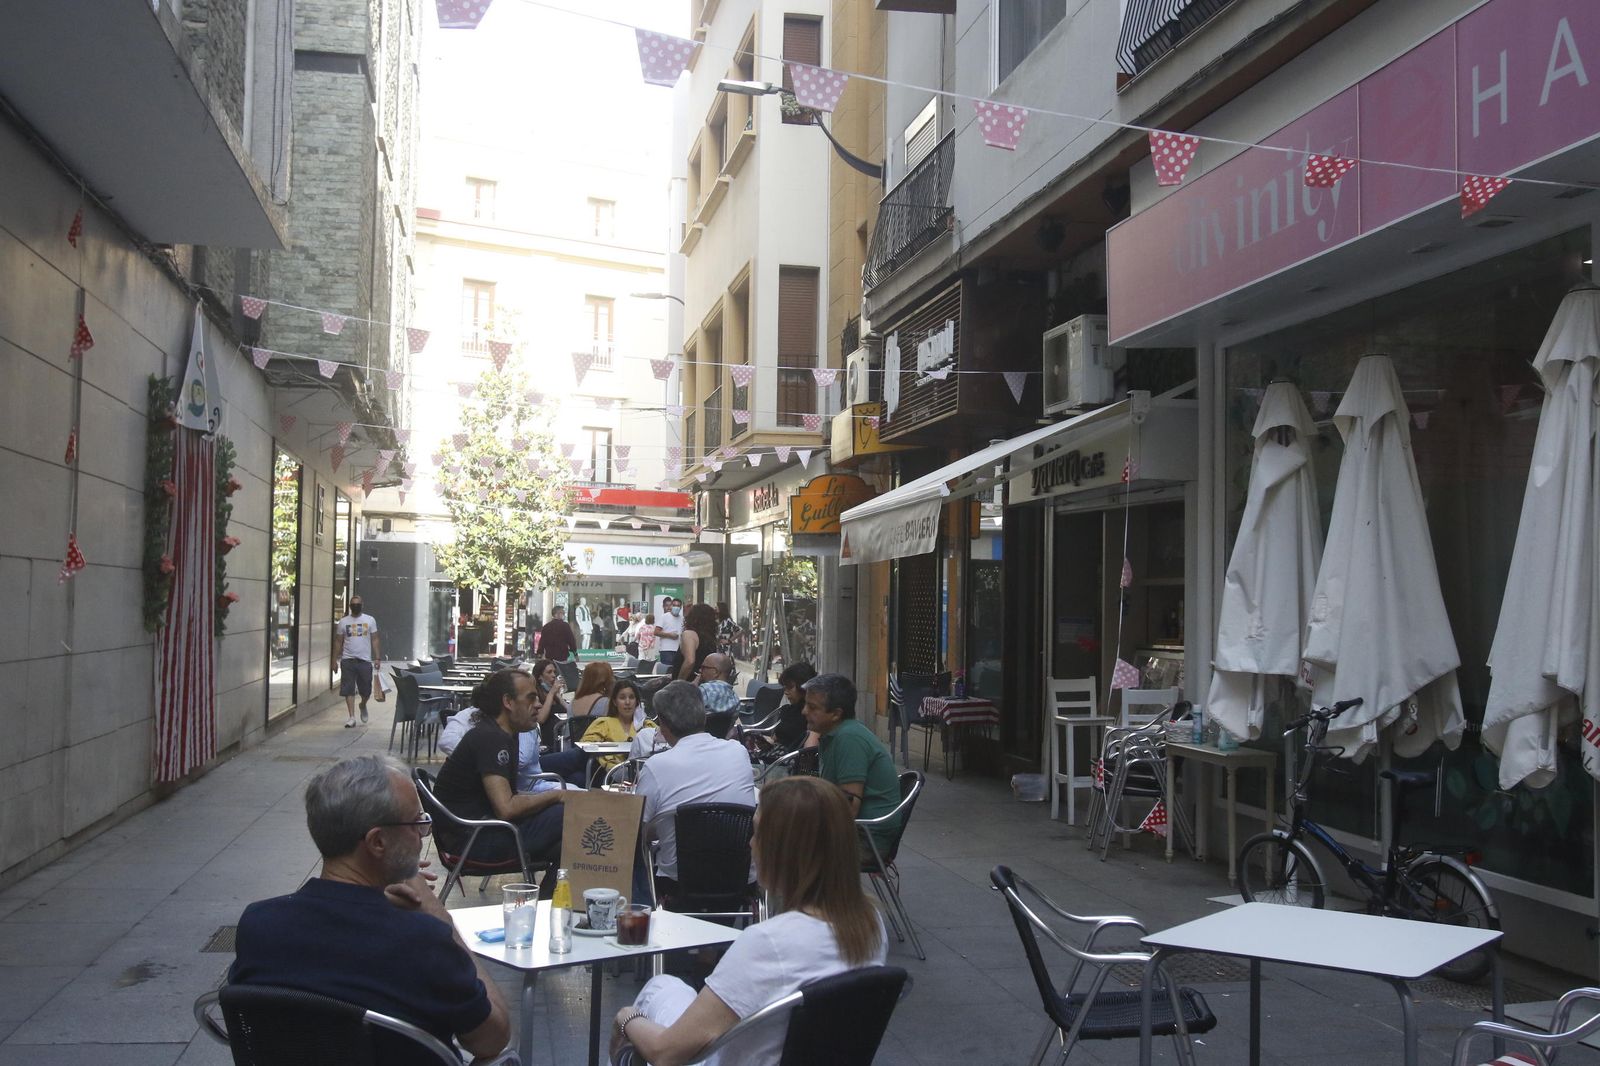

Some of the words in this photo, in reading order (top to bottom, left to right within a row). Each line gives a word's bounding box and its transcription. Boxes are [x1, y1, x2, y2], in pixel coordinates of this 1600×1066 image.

[611, 556, 643, 566] TIENDA
[645, 557, 679, 567] OFICIAL
[572, 862, 618, 873] SPRINGFIELD
